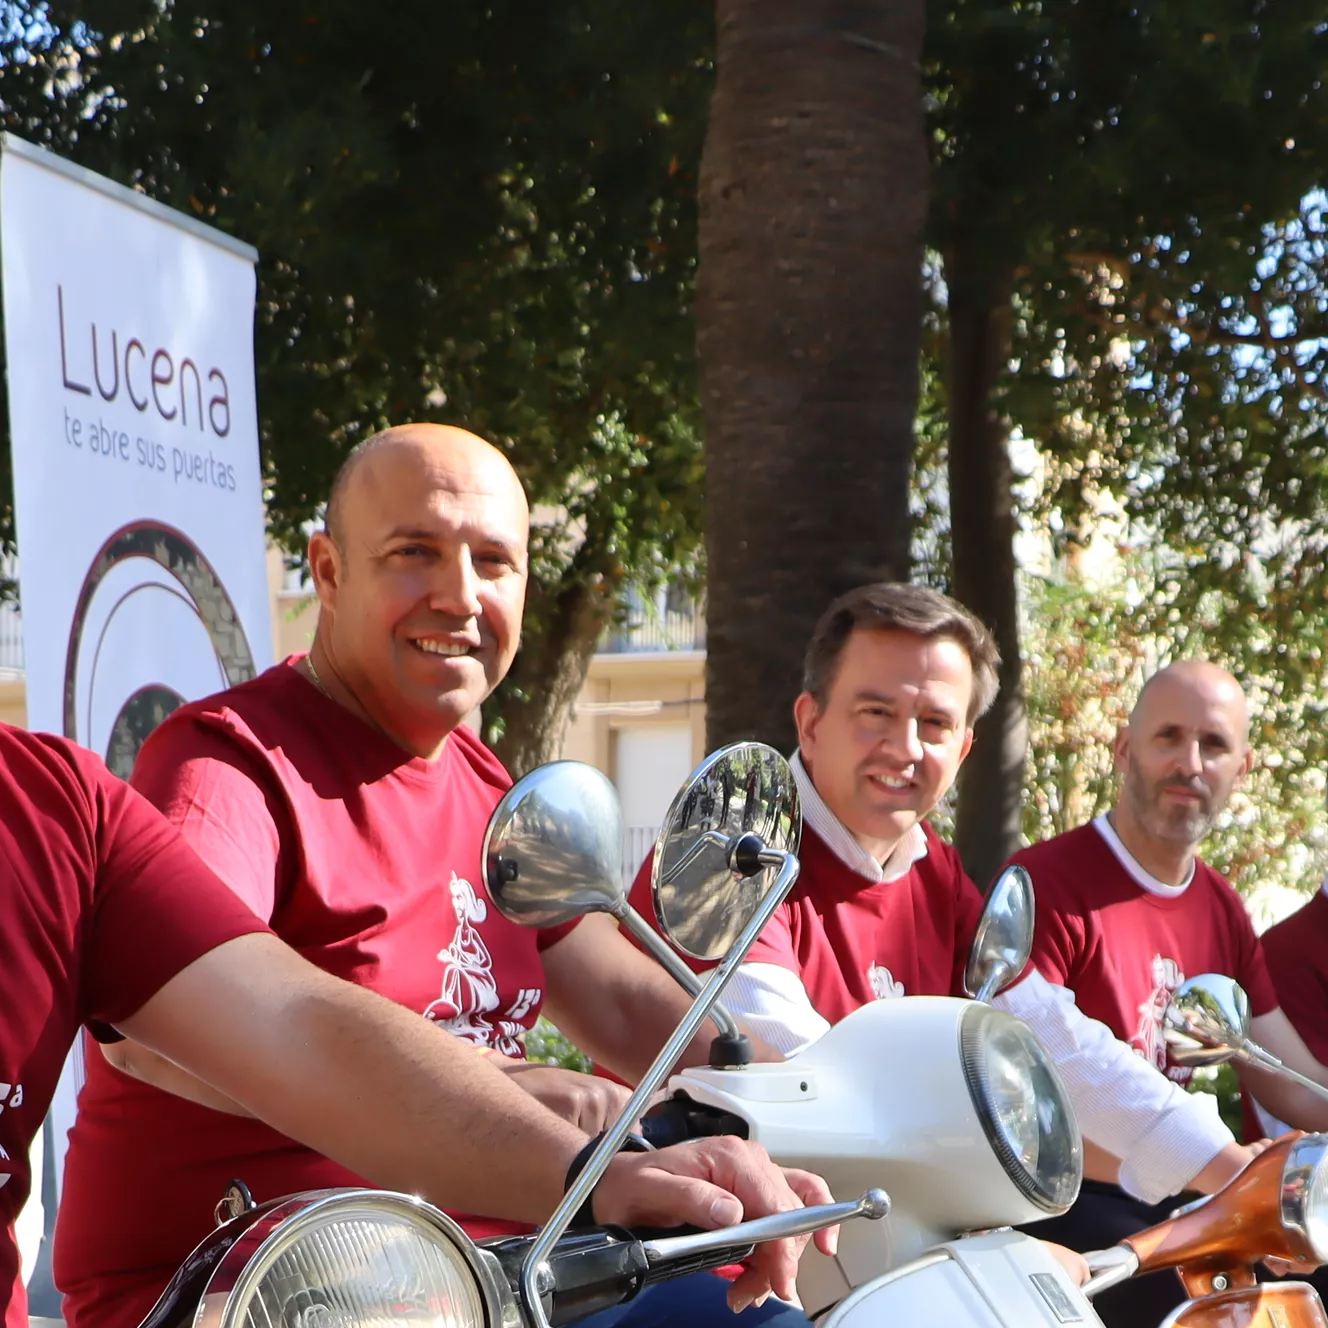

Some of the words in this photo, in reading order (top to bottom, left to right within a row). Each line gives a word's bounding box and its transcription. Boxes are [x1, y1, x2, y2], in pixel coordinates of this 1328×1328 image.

[58, 284, 231, 438] Lucena
[64, 406, 83, 449] te
[90, 417, 131, 461] abre
[136, 436, 167, 473] sus
[172, 447, 237, 493] puertas
